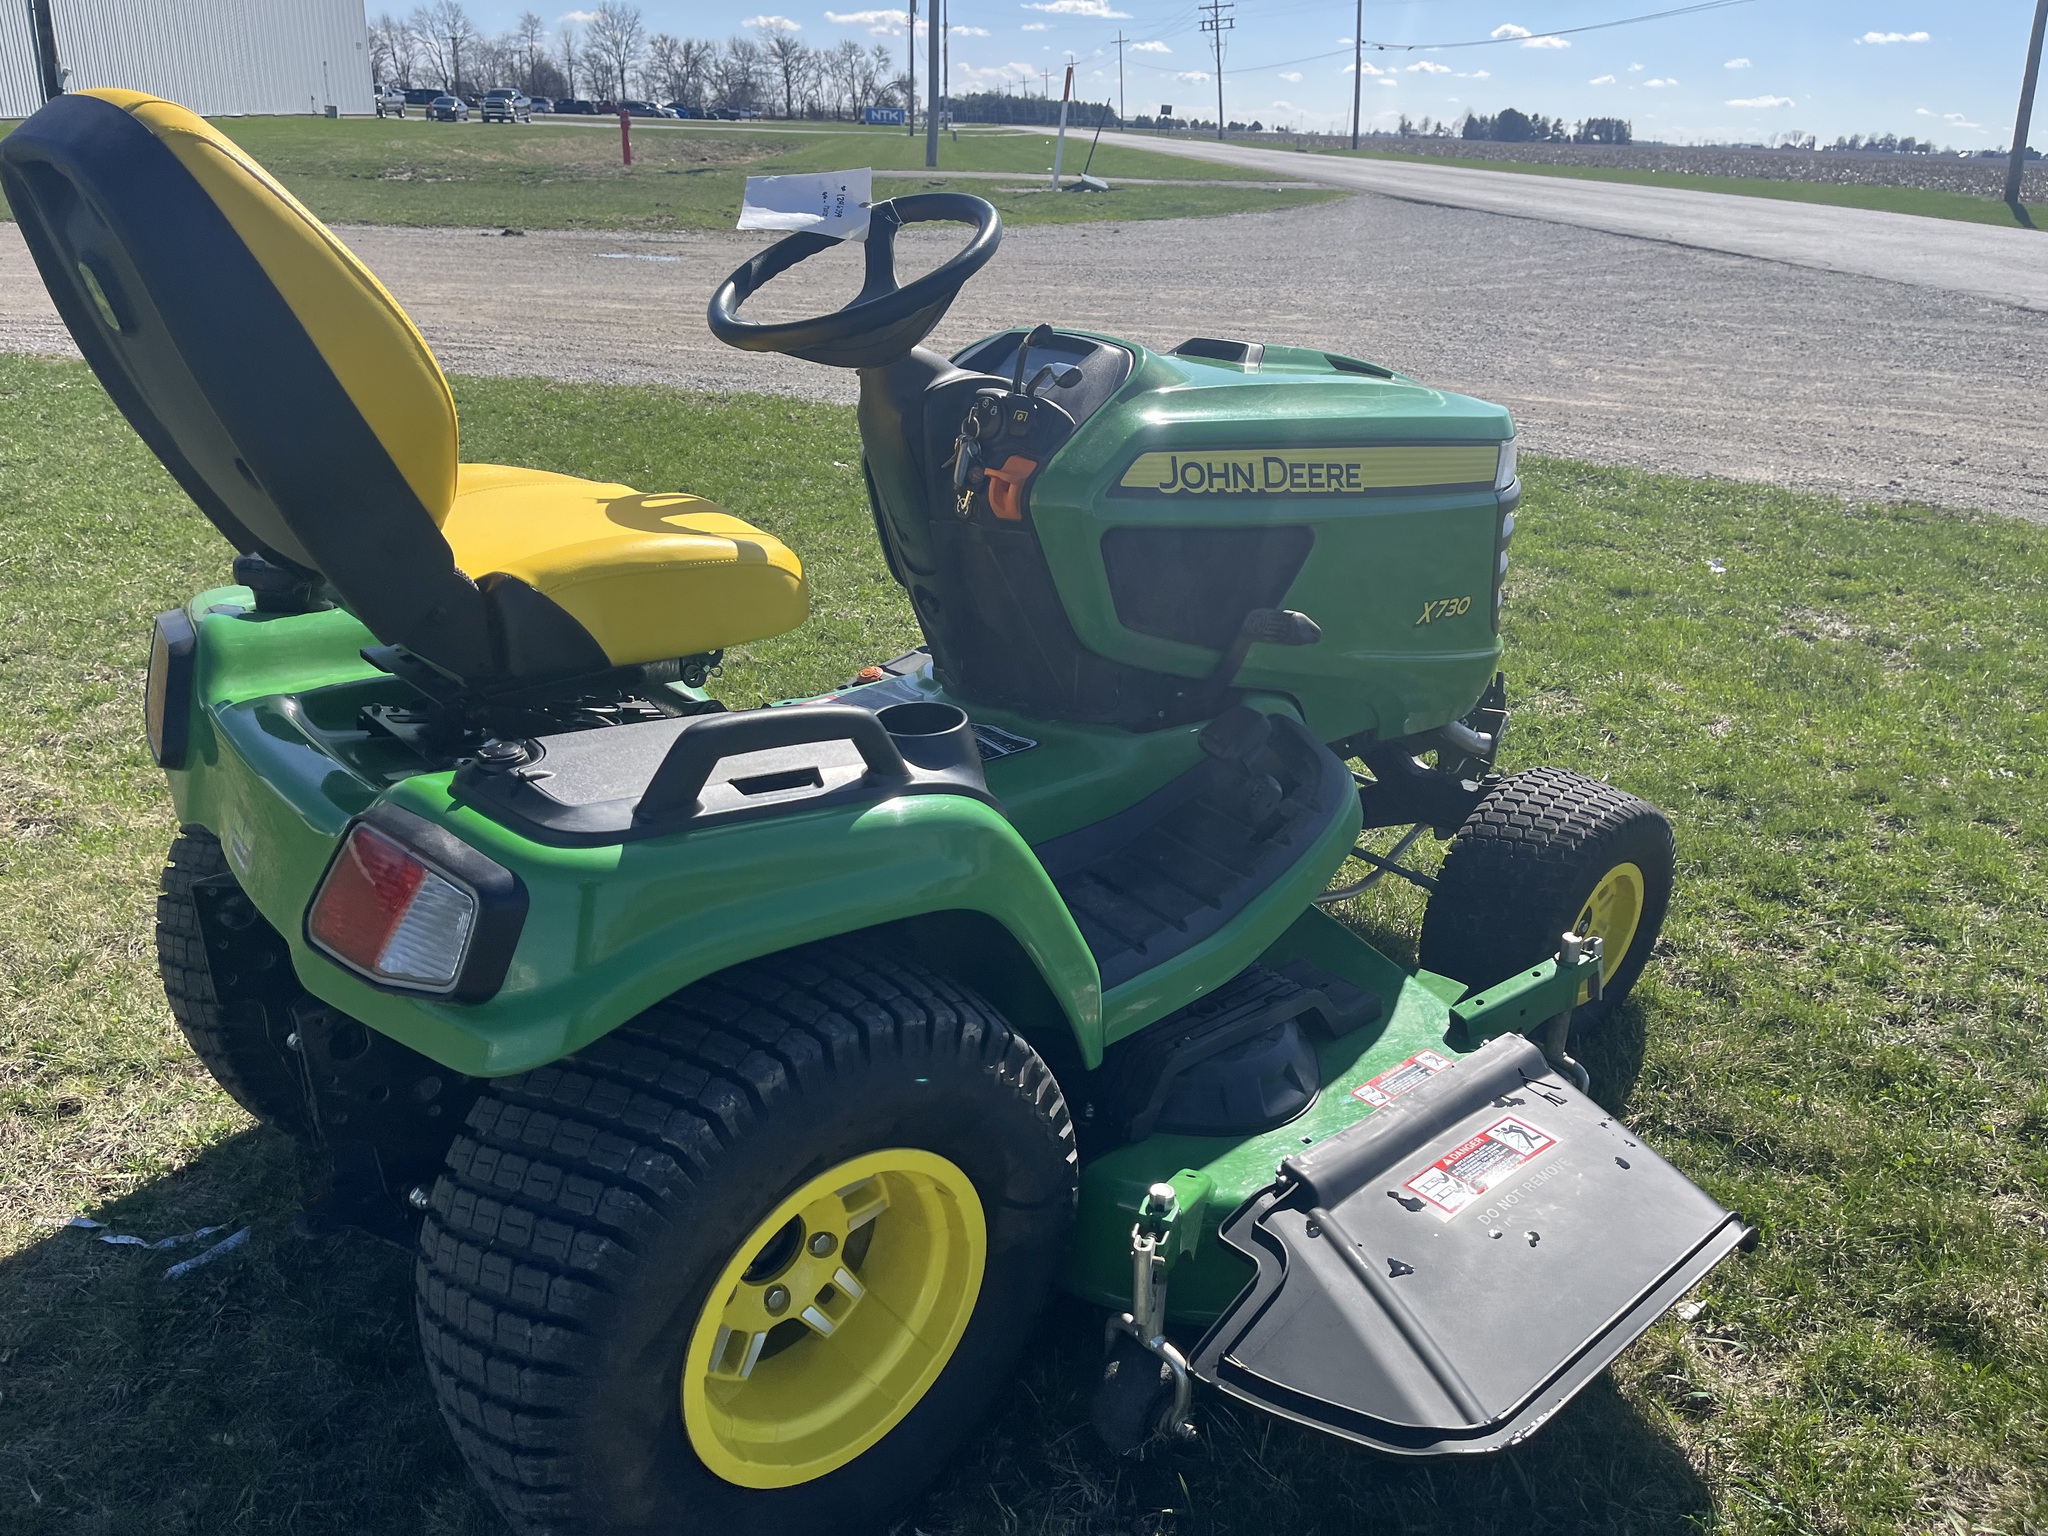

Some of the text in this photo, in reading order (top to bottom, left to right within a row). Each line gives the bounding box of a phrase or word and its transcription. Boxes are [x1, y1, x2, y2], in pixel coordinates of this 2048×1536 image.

[871, 110, 899, 121] NTK
[1160, 455, 1362, 490] JOHN DEERE
[1416, 596, 1472, 625] X730
[1450, 1137, 1485, 1160] DANGER
[1477, 1209, 1499, 1226] DO
[1501, 1188, 1525, 1211] NOT
[1523, 1157, 1572, 1193] REMOVE
